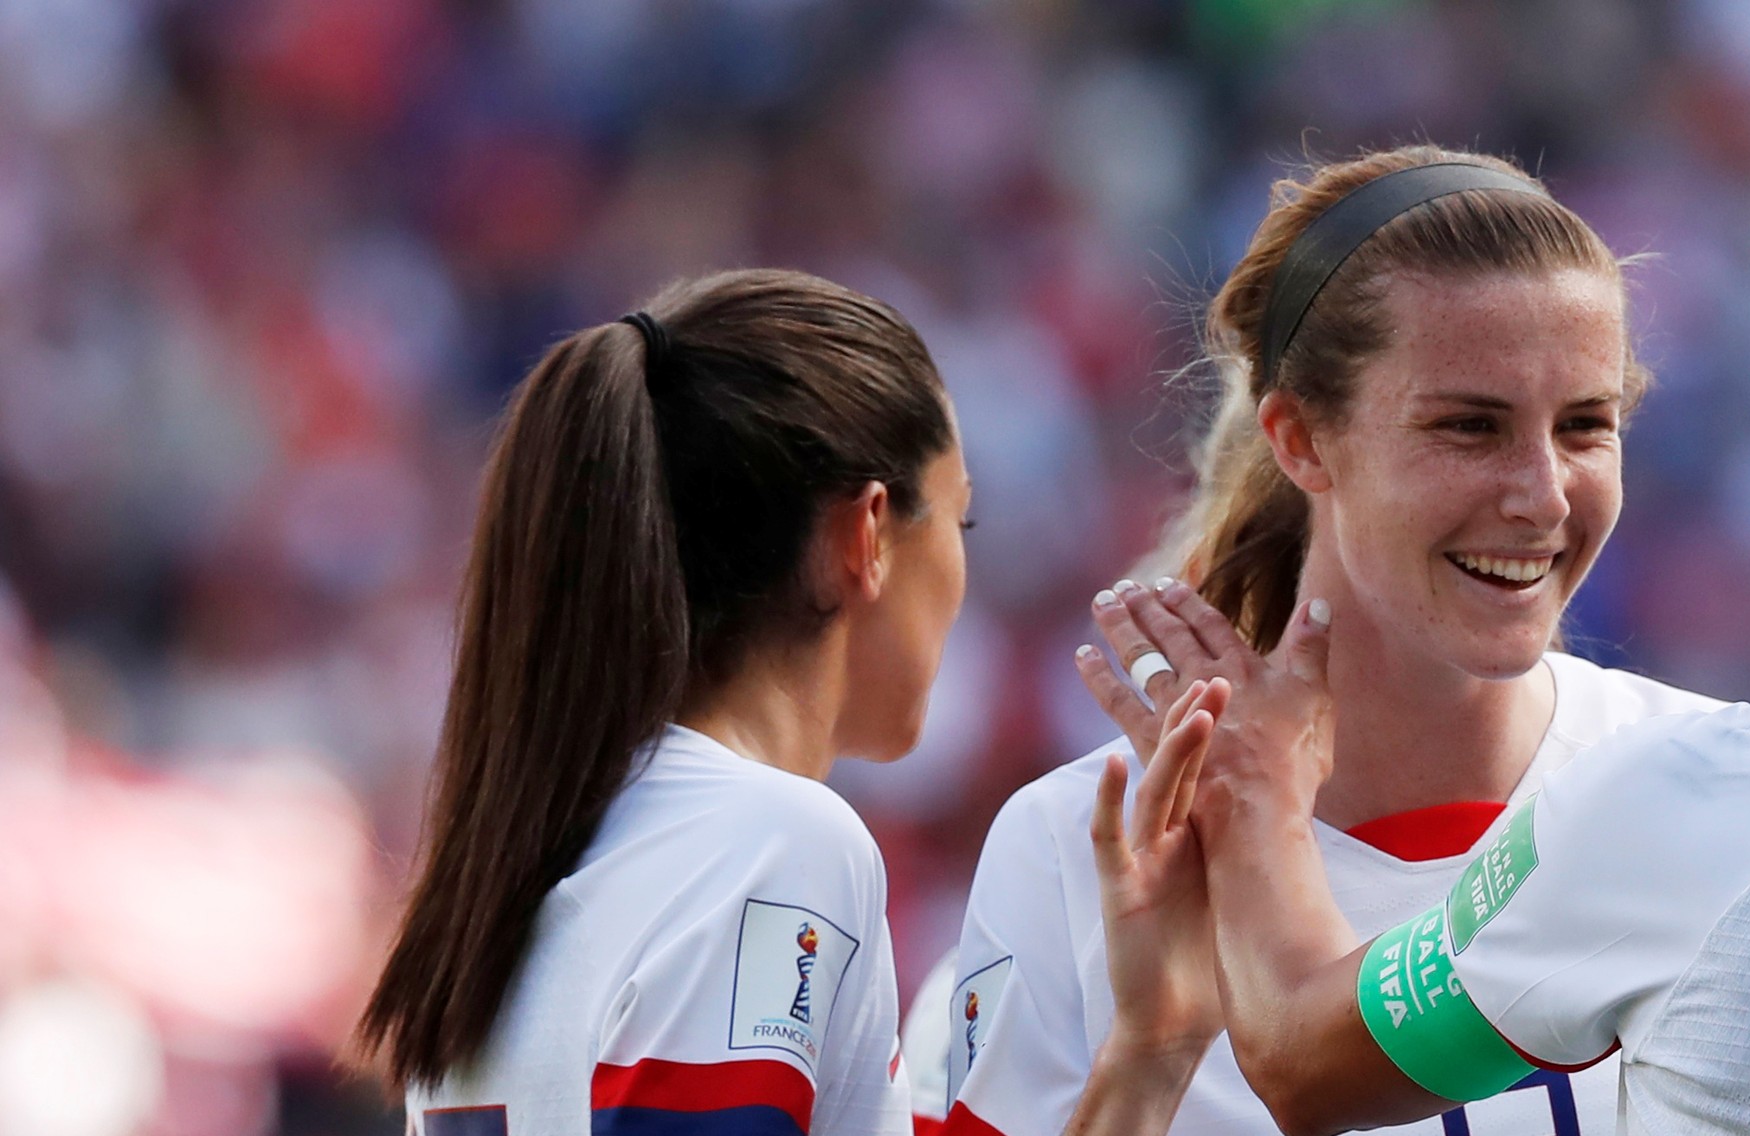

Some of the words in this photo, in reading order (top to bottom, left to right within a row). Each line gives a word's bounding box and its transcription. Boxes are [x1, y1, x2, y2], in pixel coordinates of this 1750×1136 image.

[1471, 873, 1489, 921] FIFA
[1380, 941, 1408, 1029] FIFA
[1418, 915, 1445, 1008] BALL
